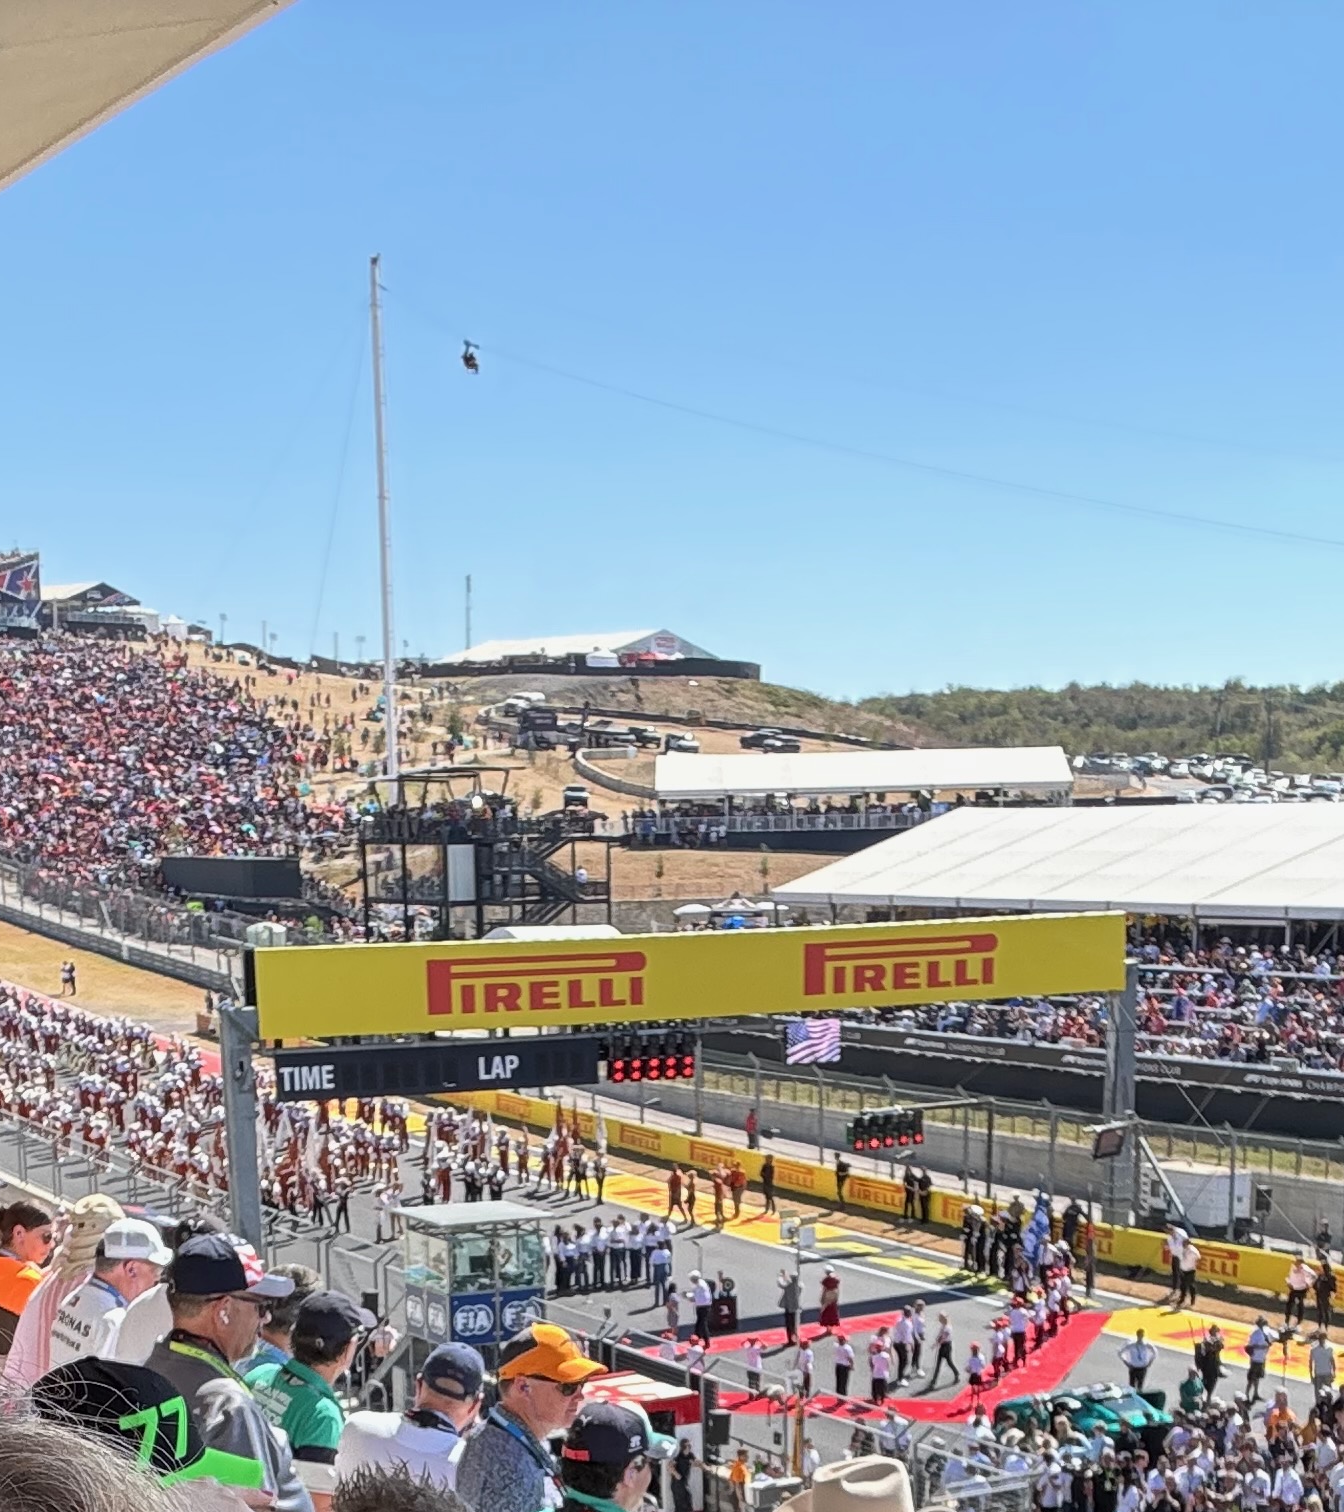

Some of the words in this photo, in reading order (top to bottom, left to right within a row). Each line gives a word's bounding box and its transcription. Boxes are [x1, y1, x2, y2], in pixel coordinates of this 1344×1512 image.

[426, 951, 647, 1016] PIRELLI
[803, 933, 999, 996] PIRELLI
[279, 1064, 336, 1092] TIME
[478, 1055, 520, 1081] LAP
[119, 1396, 188, 1470] 77
